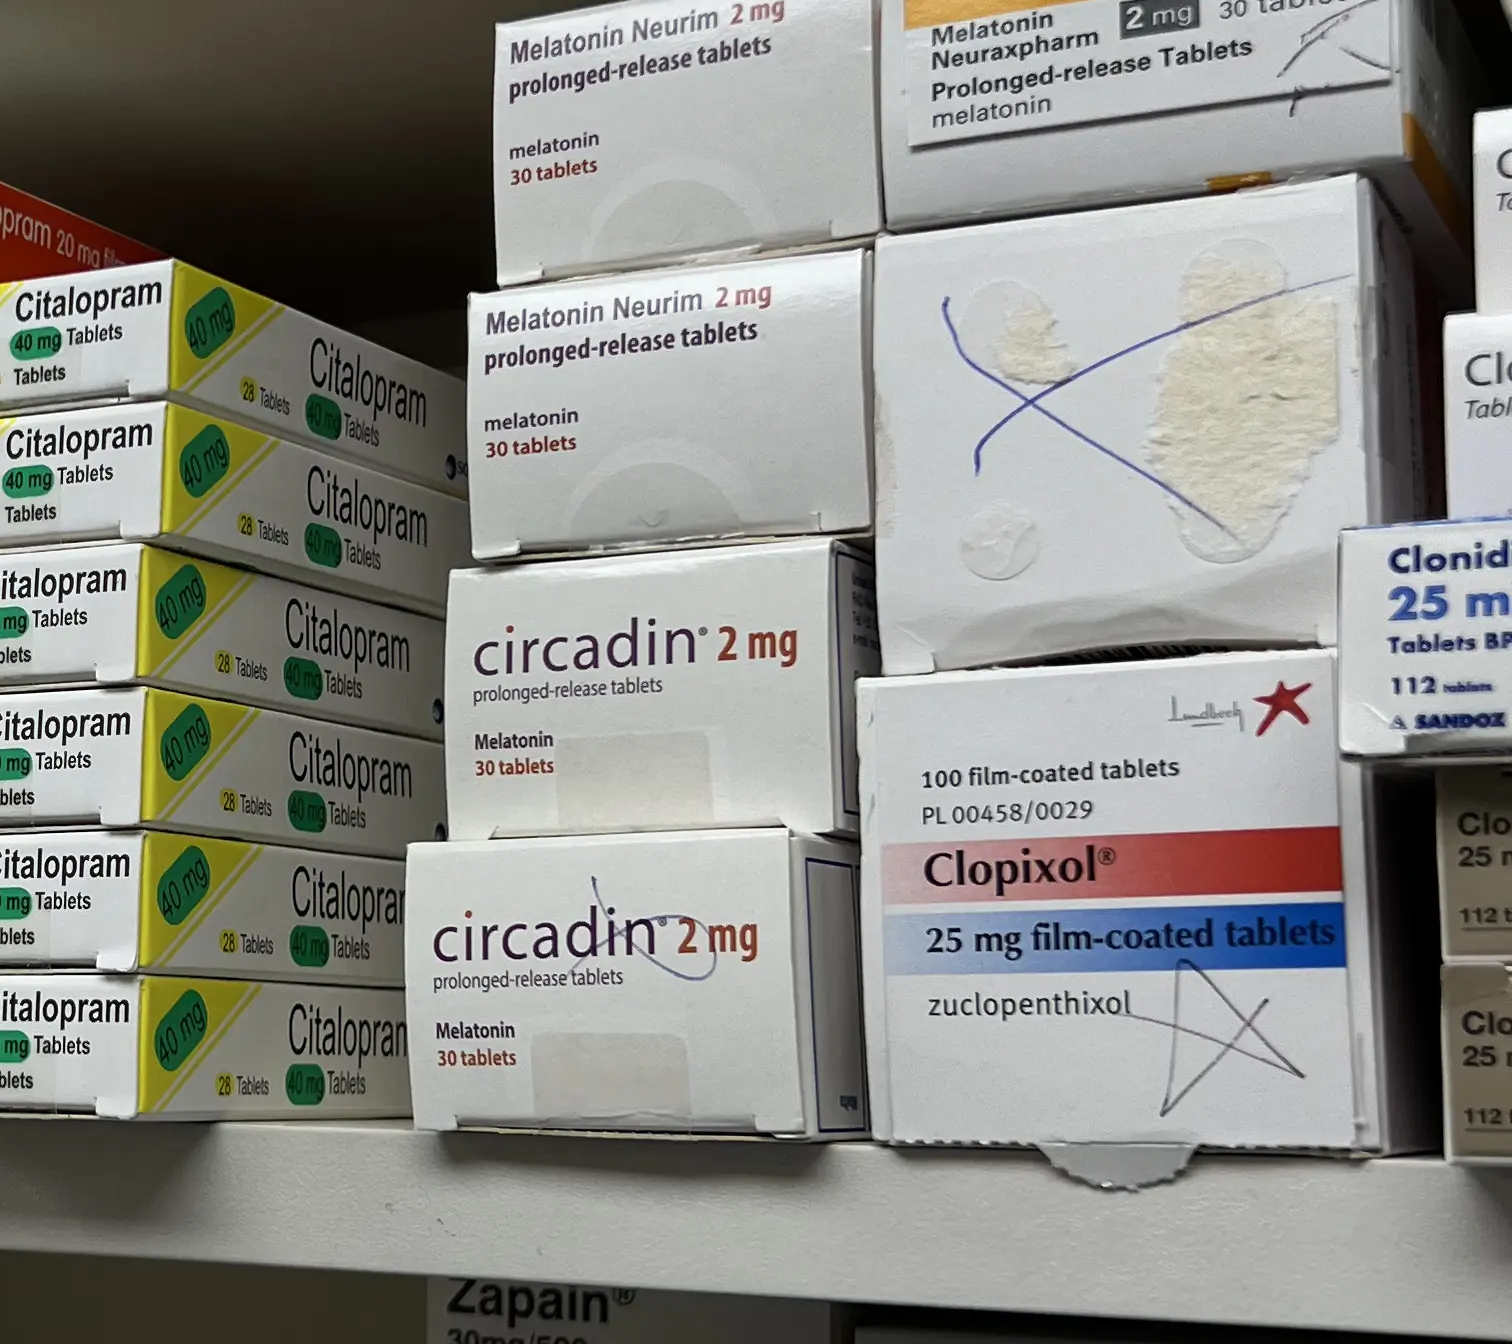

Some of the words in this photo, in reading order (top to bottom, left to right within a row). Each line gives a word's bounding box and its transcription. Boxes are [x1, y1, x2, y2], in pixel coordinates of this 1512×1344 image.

[510, 25, 624, 66] Melatonin
[631, 9, 719, 44] Neurim
[730, 2, 744, 25] 2
[931, 12, 1054, 47] Melatonin
[1125, 7, 1144, 30] 2
[1151, 5, 1194, 31] mg
[931, 28, 1100, 72] Neuraxpharm
[508, 49, 693, 104] prolonged-release
[697, 35, 772, 66] tablets
[931, 54, 1151, 103] Prolonged-release
[1161, 37, 1253, 69] Tablets
[931, 95, 1052, 129] melatonin
[14, 279, 163, 322] Citalopram
[14, 333, 33, 352] 40
[37, 332, 62, 354] mg
[66, 322, 123, 346] Tablets
[718, 626, 737, 662] 2
[748, 628, 798, 666] mg
[472, 678, 607, 706] prolonged-release
[611, 678, 663, 696] tablets
[1415, 711, 1504, 729] SANDOZ
[474, 730, 553, 750] Melatonin
[921, 769, 962, 789] 100
[968, 761, 1093, 787] film-coated
[1100, 758, 1180, 780] tablets
[921, 806, 948, 825] PL
[952, 799, 1093, 825] 00458/0029
[925, 927, 963, 953] 25
[974, 930, 1022, 961] mg
[1031, 918, 1212, 952] film-coated
[1226, 918, 1336, 947] tablets
[928, 989, 1131, 1021] zuclopenthixol
